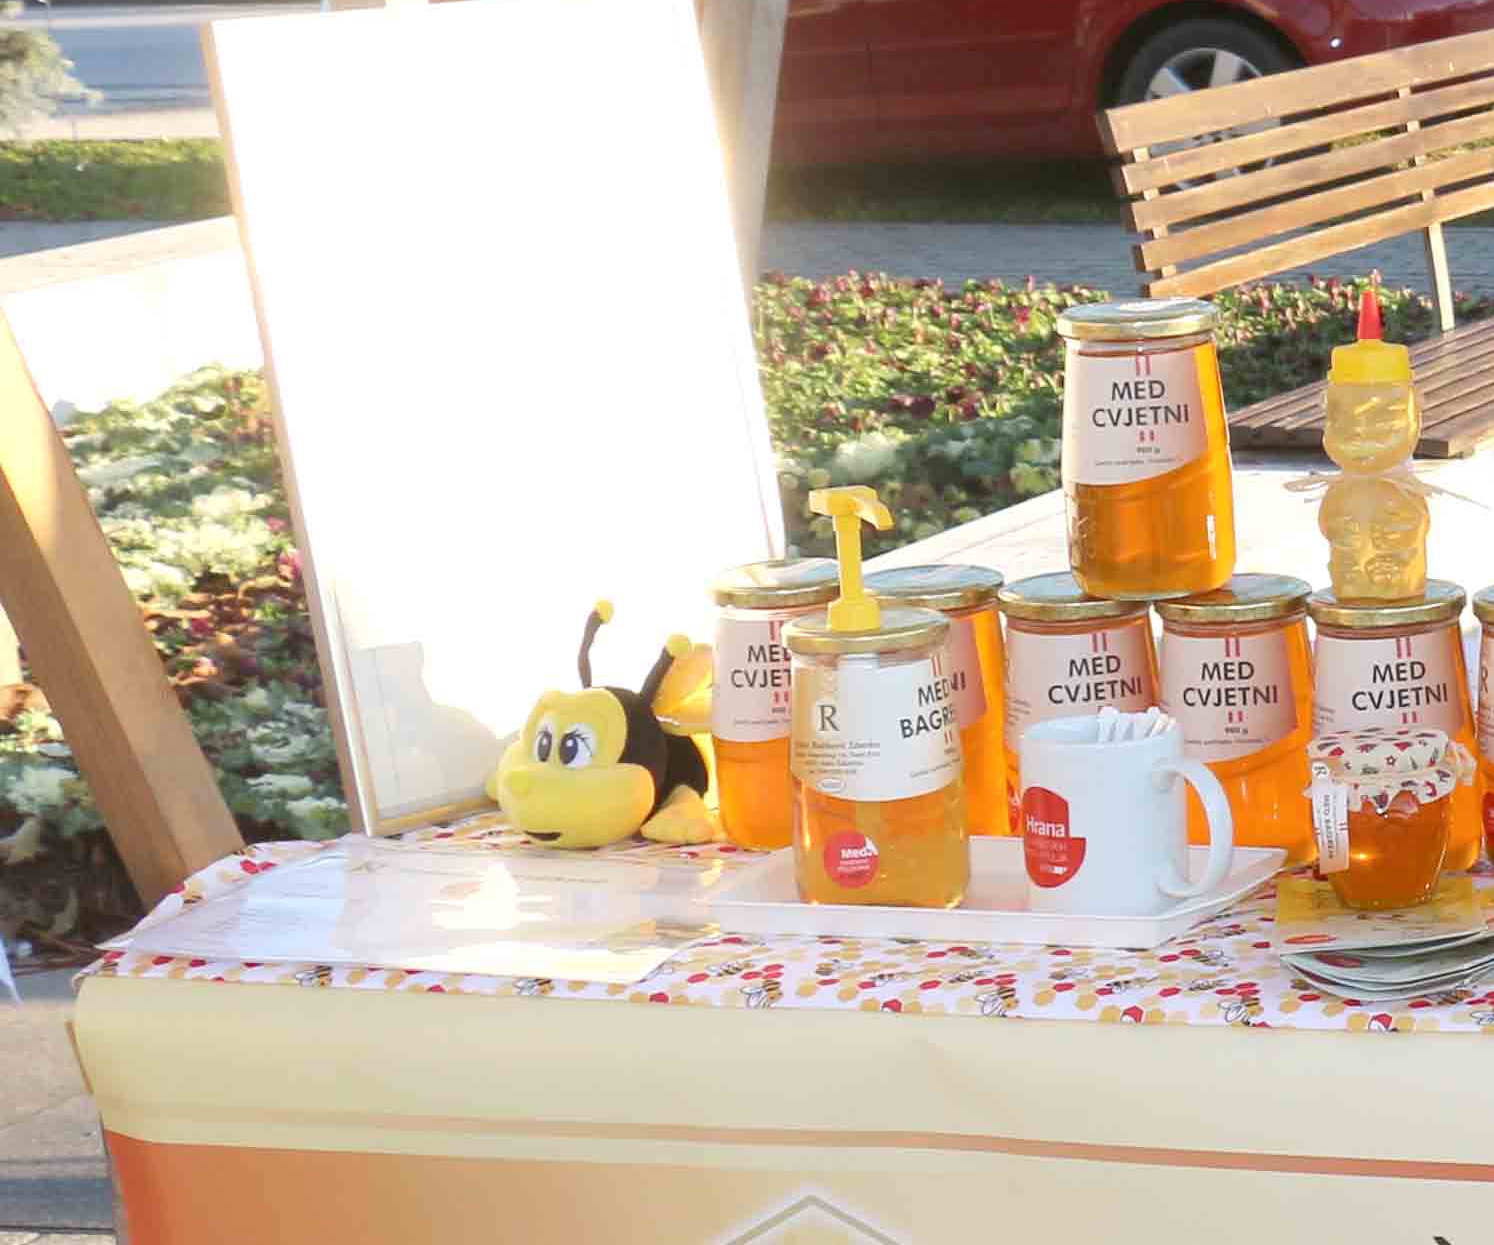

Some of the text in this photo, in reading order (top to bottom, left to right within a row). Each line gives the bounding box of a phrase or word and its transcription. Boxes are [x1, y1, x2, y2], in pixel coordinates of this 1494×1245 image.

[1112, 380, 1165, 401] MED
[1092, 404, 1189, 427] CVJETNI
[1068, 655, 1121, 677] MED
[1201, 661, 1255, 681] MED
[1372, 661, 1425, 683] MED
[731, 669, 791, 688] CVJET
[1048, 677, 1143, 704] CVJETNI
[1183, 686, 1278, 707] CVJETNI
[1351, 683, 1448, 711] CVJETNI
[818, 704, 840, 731] R
[1026, 814, 1065, 838] Hrana
